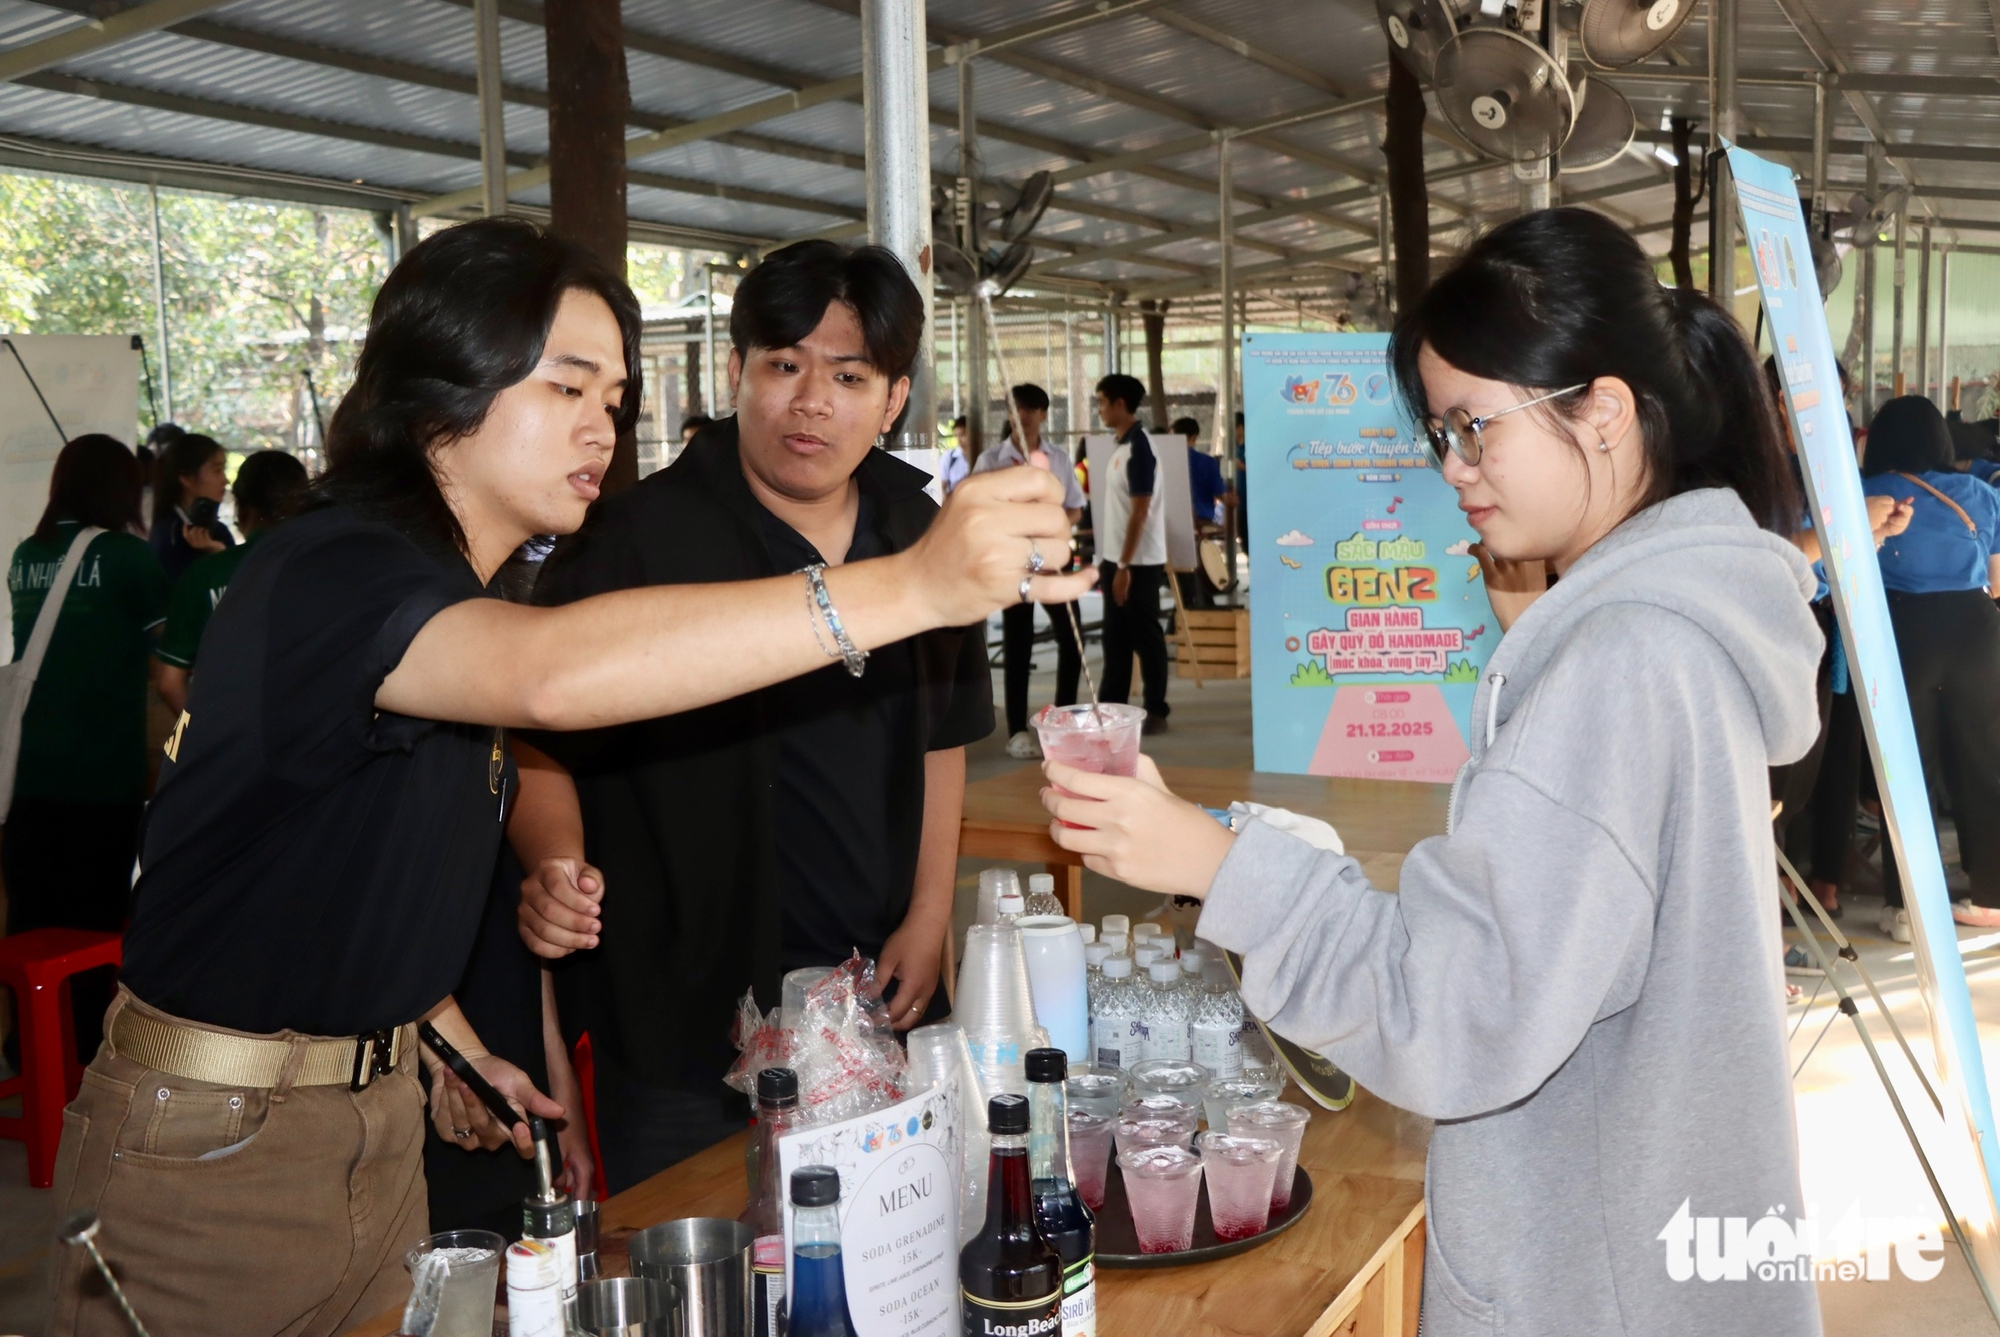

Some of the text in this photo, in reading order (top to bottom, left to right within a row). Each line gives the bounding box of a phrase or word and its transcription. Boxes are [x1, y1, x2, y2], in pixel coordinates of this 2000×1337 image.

[1309, 441, 1332, 458] Tiếp
[1337, 534, 1424, 561] SẮC MÀU
[77, 554, 102, 588] LÁ
[1350, 610, 1418, 627] GIAN HÀNG
[1312, 633, 1335, 650] GÂY
[1340, 633, 1364, 651] QUỸ
[1388, 633, 1458, 648] HANDMADE
[1388, 655, 1412, 669] vòng
[1346, 722, 1433, 738] 21.12.2025
[879, 1173, 932, 1217] MENU
[862, 1214, 945, 1262] SODA GRENADINE
[898, 1249, 923, 1265] -15K-
[880, 1278, 940, 1317] SODA OCEAN
[900, 1308, 924, 1325] -15K-
[1063, 1298, 1083, 1320] SIRÔ
[984, 1313, 1061, 1337] LongBeac
